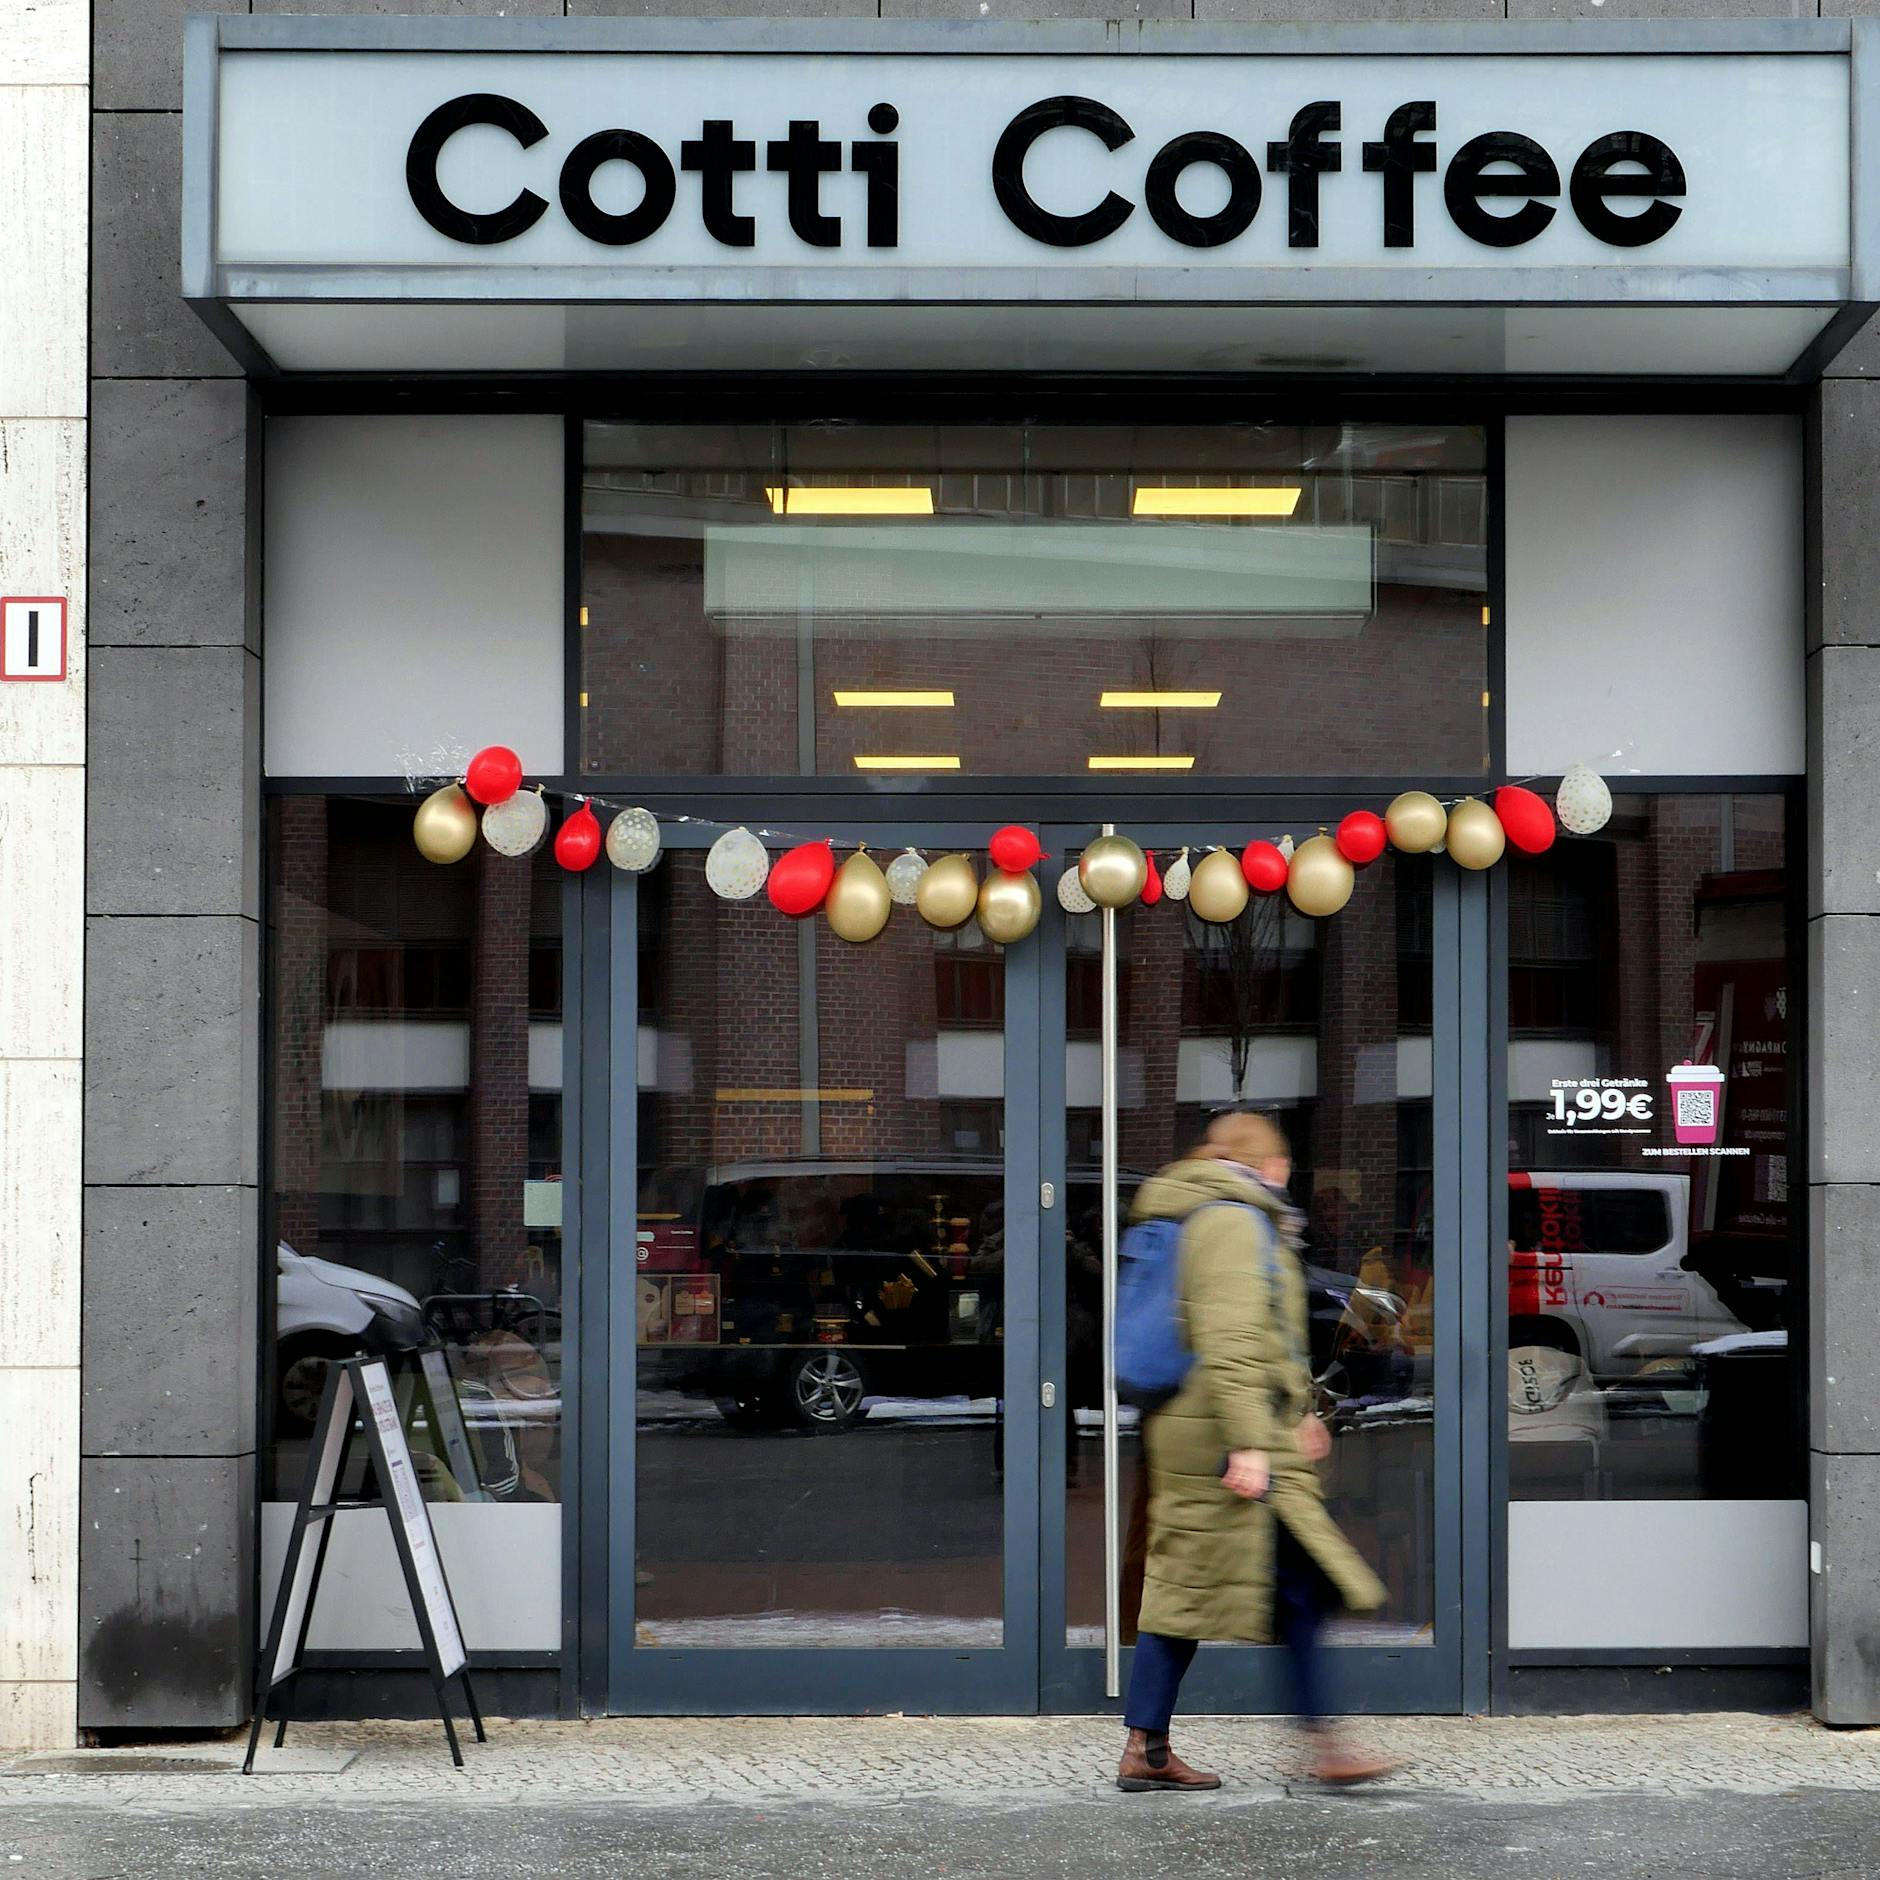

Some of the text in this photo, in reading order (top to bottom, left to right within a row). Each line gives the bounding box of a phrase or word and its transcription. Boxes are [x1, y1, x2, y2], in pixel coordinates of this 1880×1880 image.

[406, 93, 1687, 248] Cotti Coffee
[1551, 1078, 1648, 1088] Erste drei Getränke
[1549, 1088, 1654, 1126] 1,99€
[1641, 1148, 1750, 1156] ZUM BESTELLEN SCANNEN
